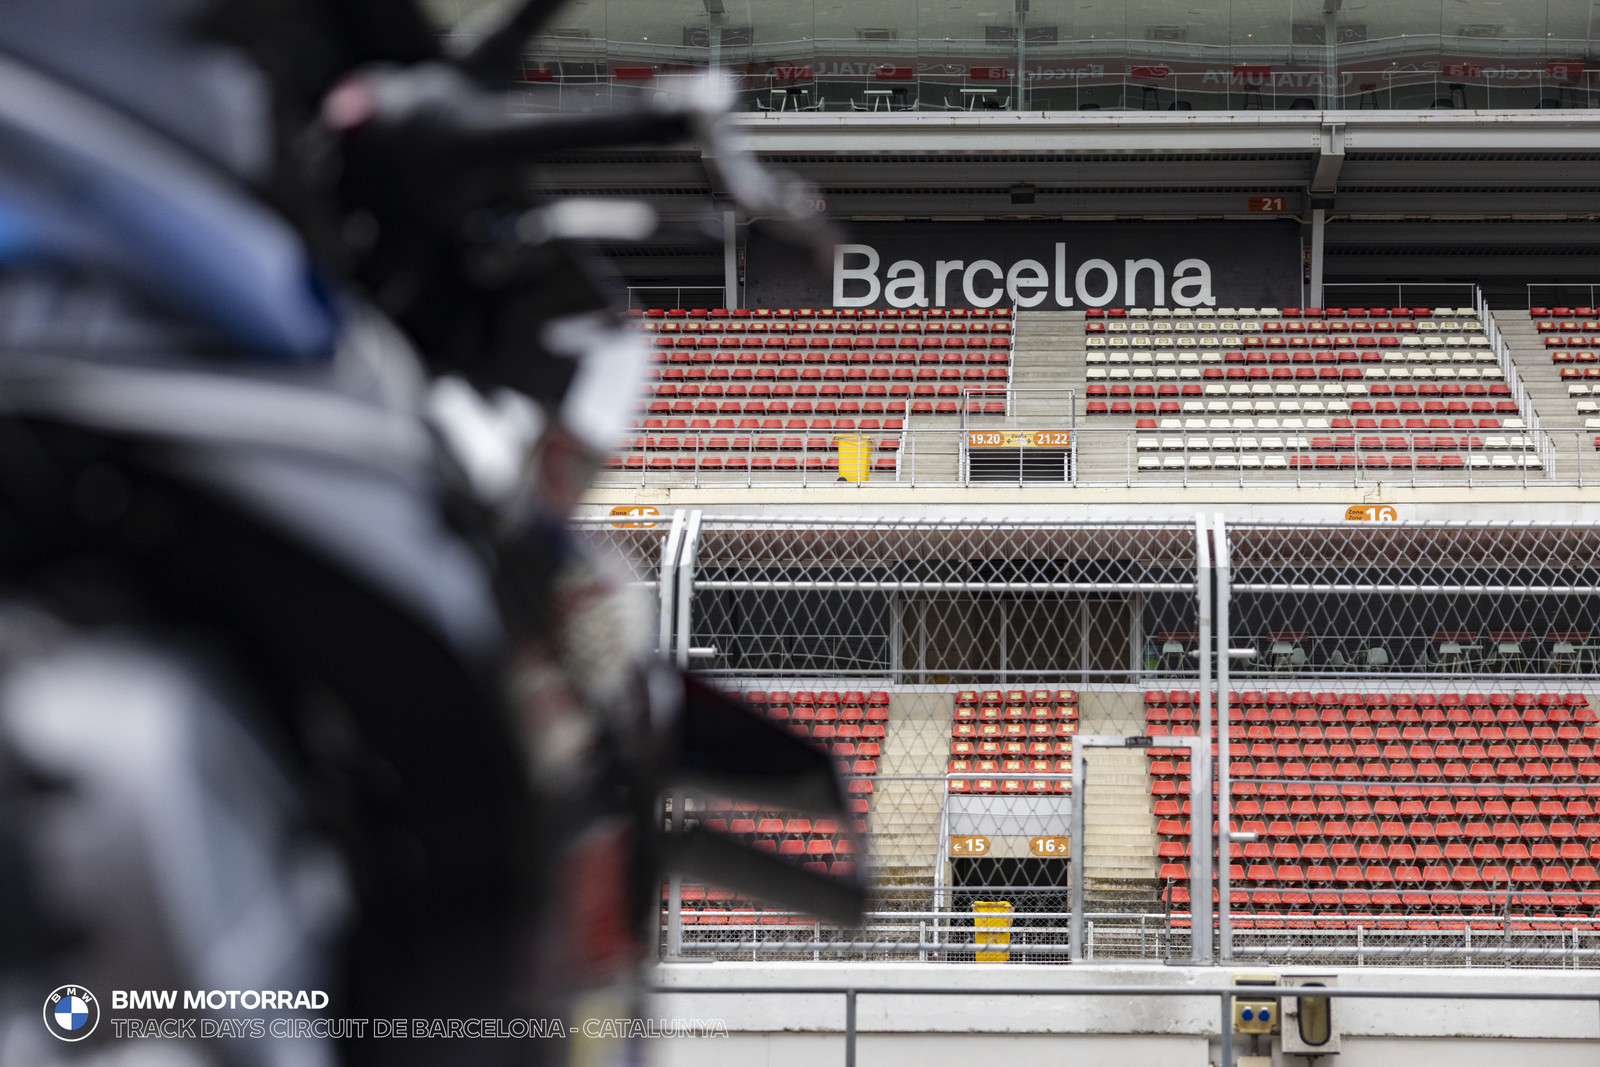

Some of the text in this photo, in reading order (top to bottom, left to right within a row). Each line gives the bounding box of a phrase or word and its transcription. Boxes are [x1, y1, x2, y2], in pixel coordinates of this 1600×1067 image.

[1262, 198, 1282, 211] 21
[833, 242, 1216, 308] Barcelona
[970, 434, 1001, 444] 19.20
[1037, 434, 1068, 444] 21.22
[629, 508, 655, 526] 15
[1365, 507, 1392, 522] 16
[965, 838, 985, 852] 15
[1036, 839, 1056, 852] 16
